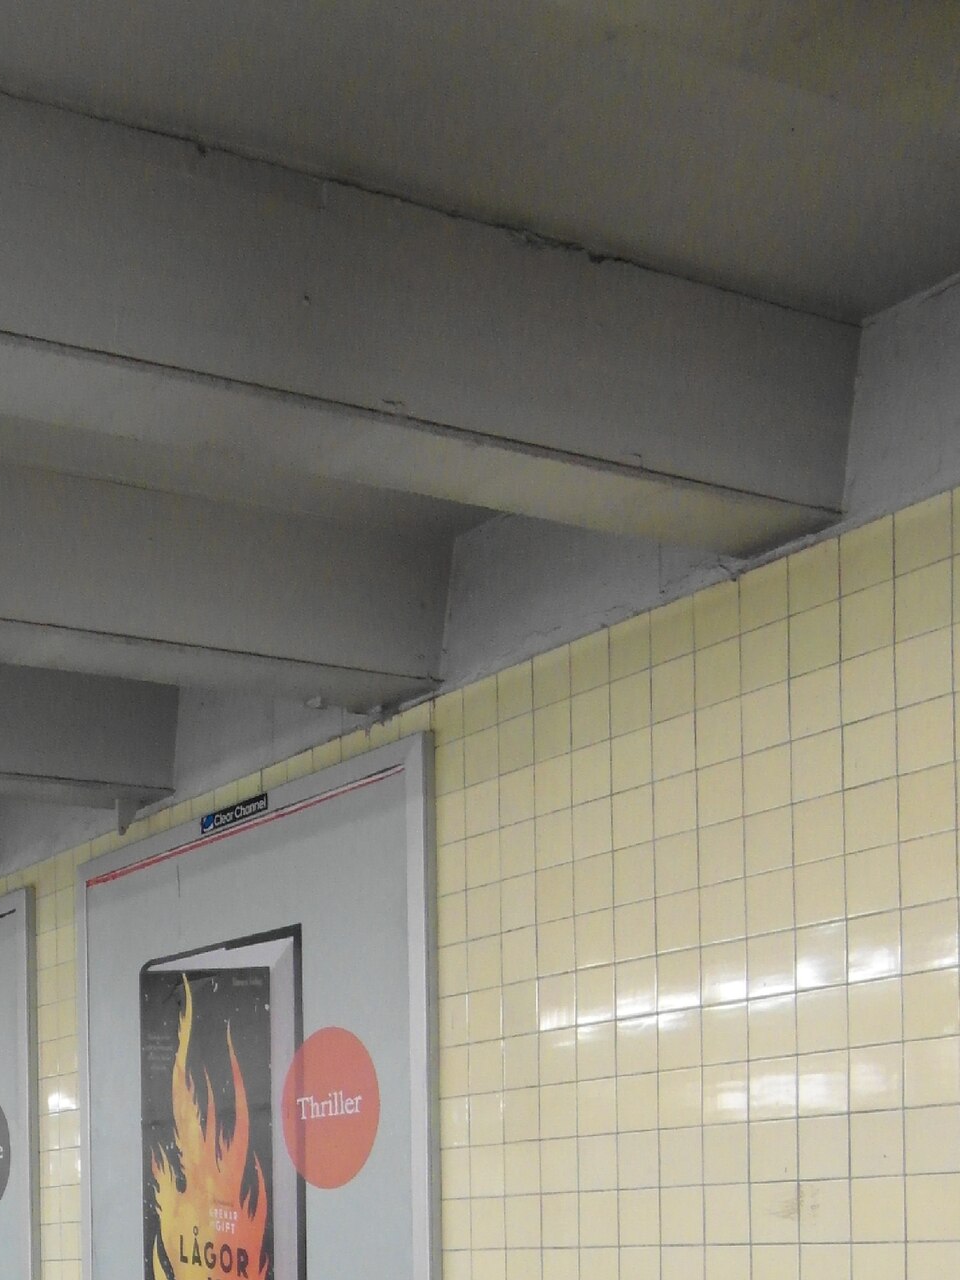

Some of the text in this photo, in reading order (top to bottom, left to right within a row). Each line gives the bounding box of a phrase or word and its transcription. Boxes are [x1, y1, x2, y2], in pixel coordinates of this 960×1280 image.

[214, 796, 266, 826] Clear Channel
[296, 1090, 363, 1120] Thriller
[179, 1226, 249, 1279] LÅGOR
